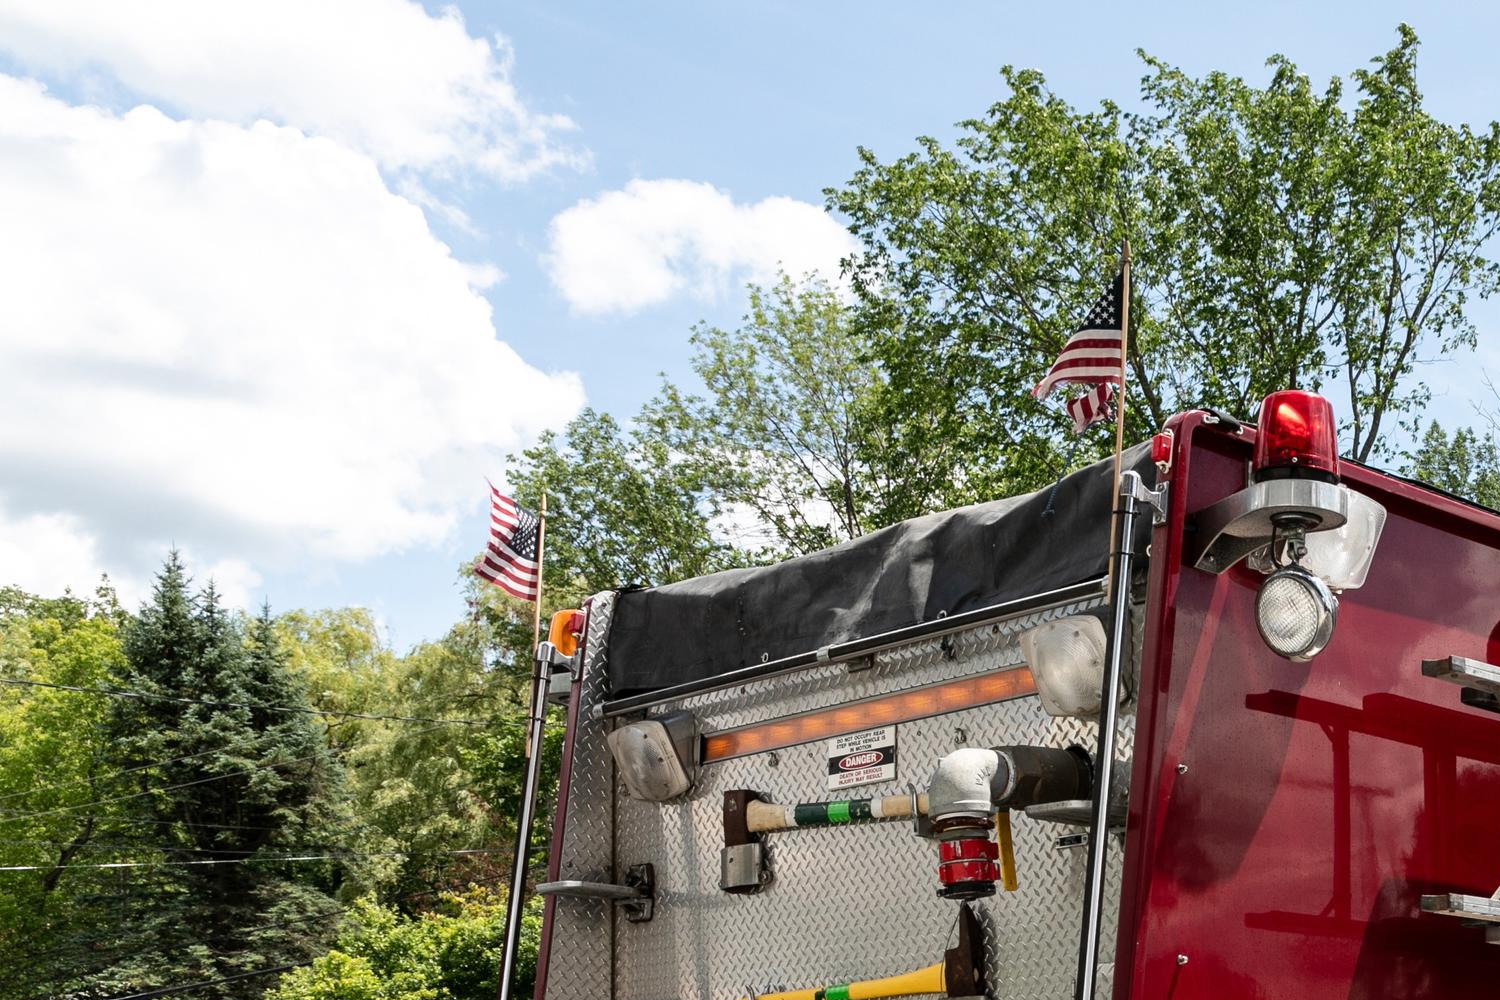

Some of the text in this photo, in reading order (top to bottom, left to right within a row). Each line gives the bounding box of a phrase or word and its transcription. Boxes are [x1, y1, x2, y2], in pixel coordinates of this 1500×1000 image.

[854, 732, 872, 740] OCCUPY
[863, 736, 880, 744] VEHICLE
[845, 753, 877, 768] DANGER
